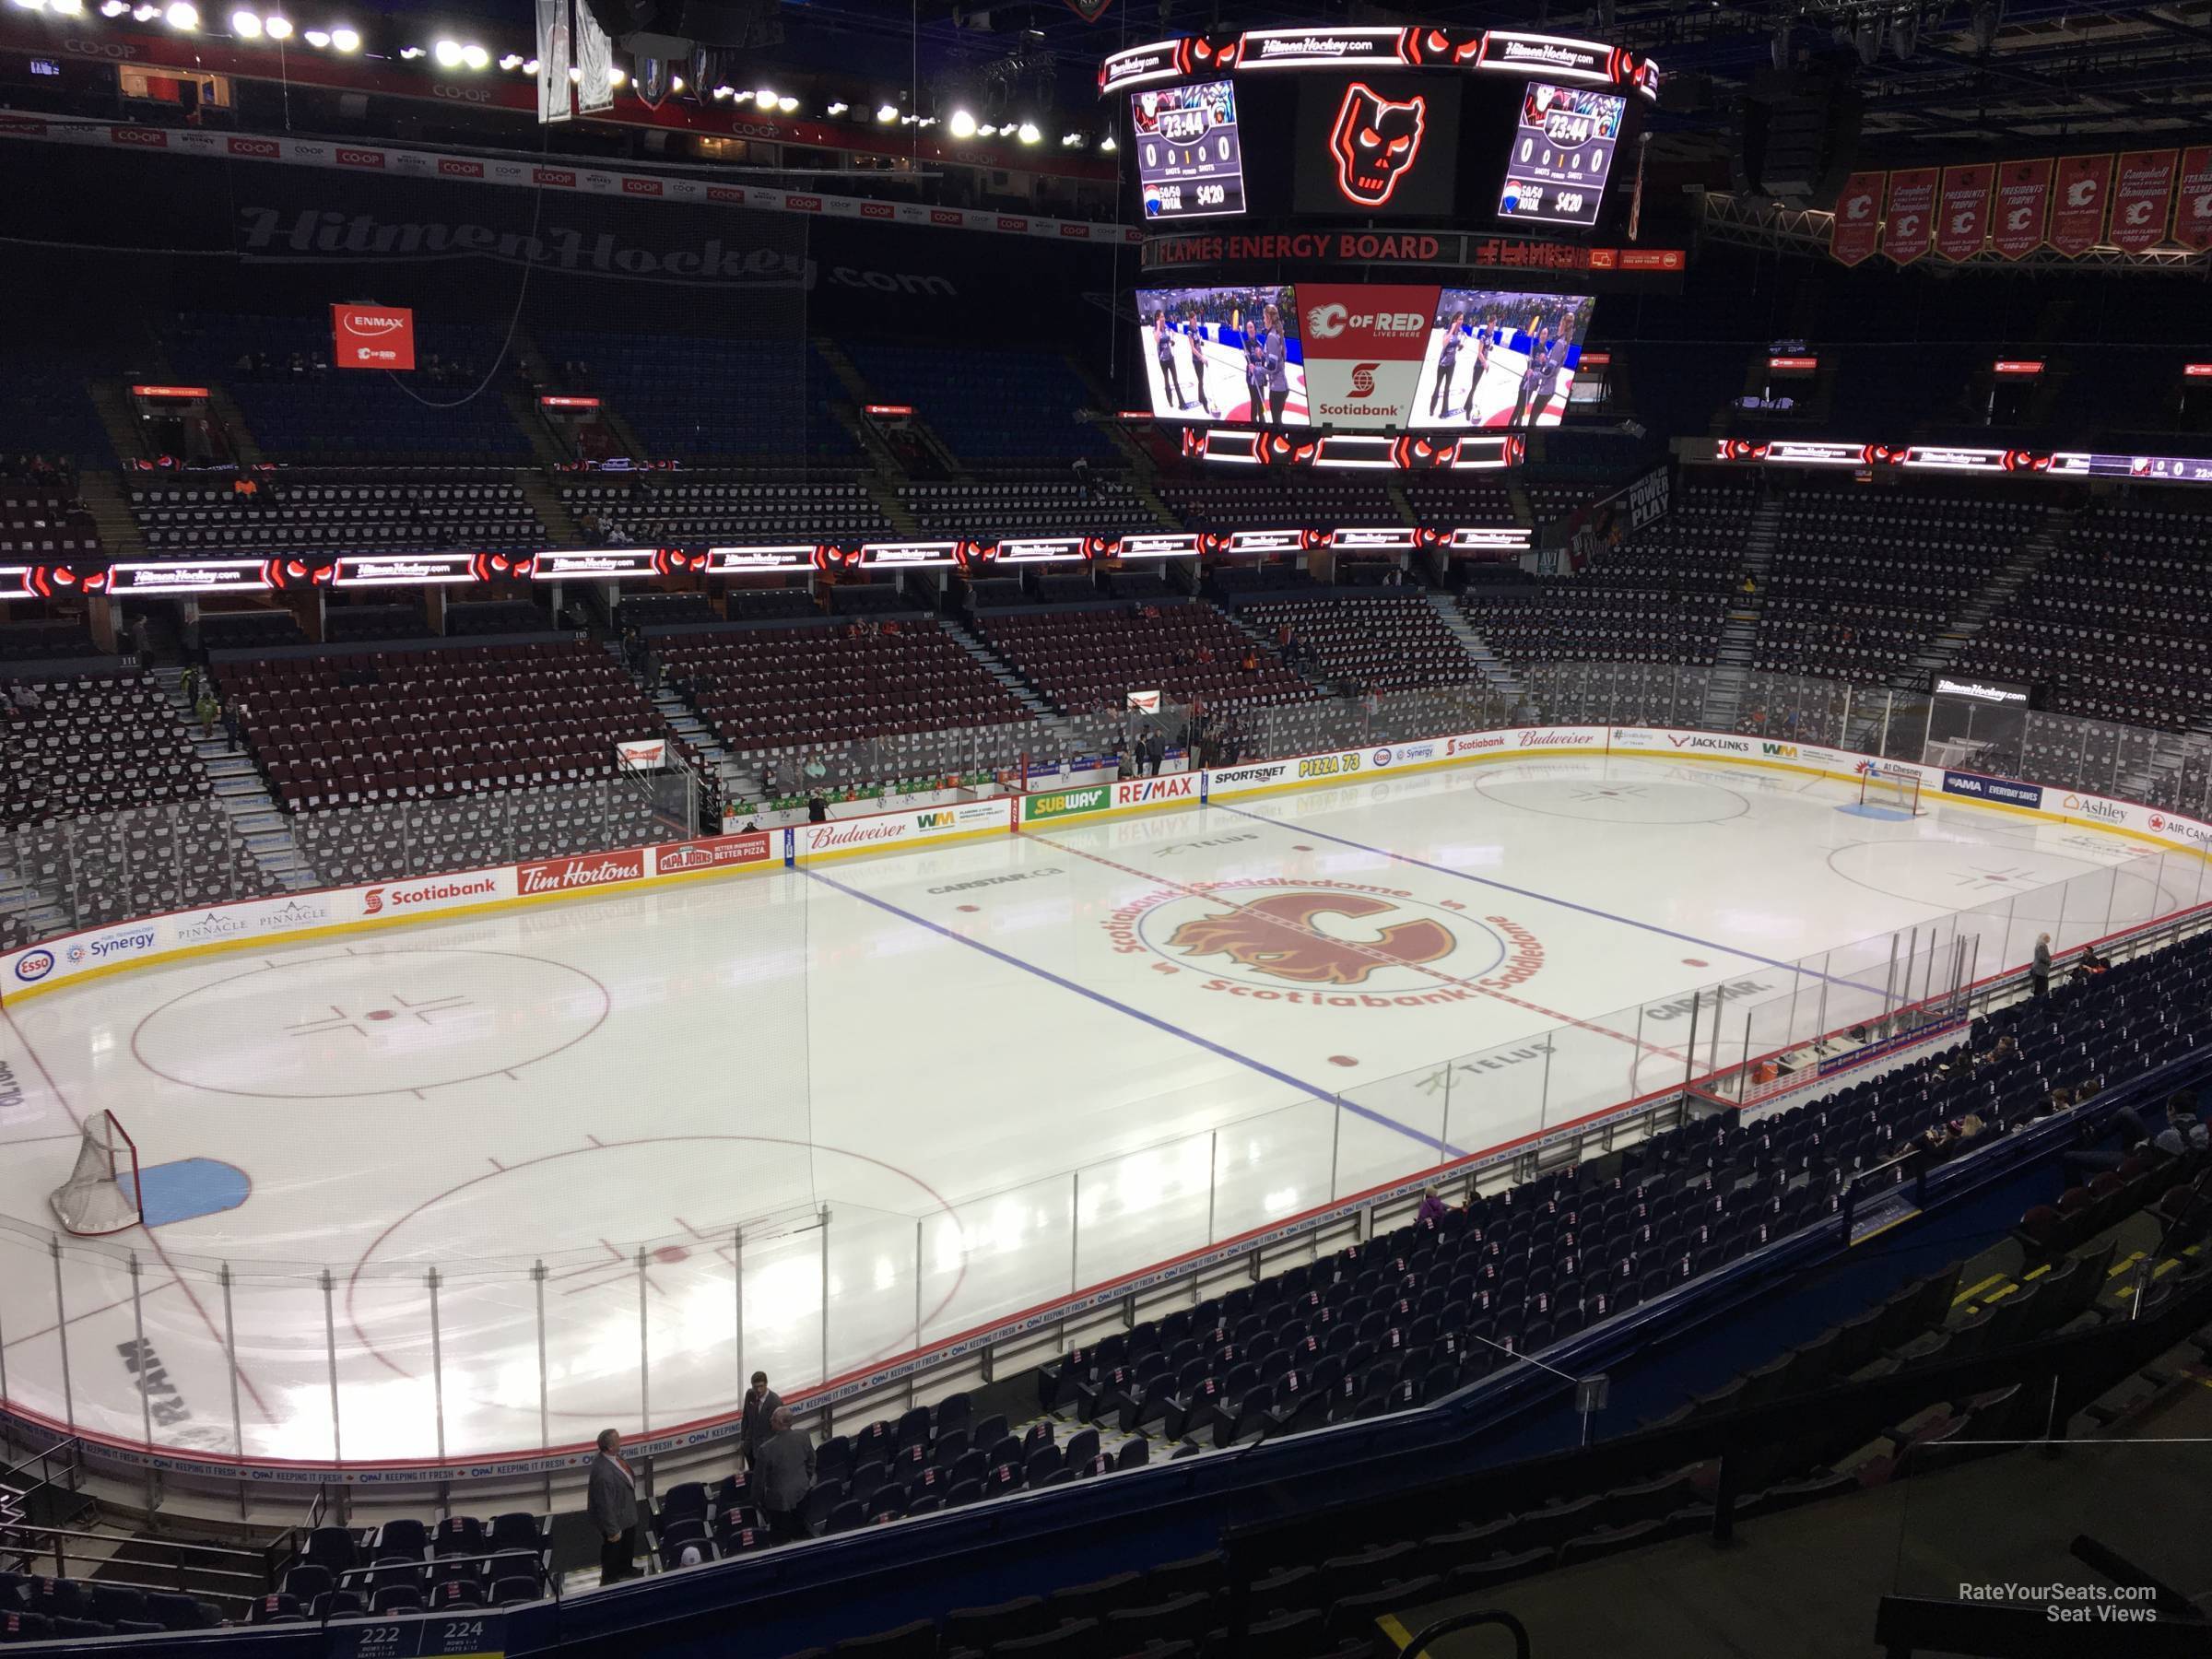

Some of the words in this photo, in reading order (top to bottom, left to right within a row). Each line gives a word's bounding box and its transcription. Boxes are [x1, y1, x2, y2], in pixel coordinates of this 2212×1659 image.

[65, 39, 137, 58] CO-OP
[432, 85, 490, 102] CO-OP
[732, 122, 780, 138] CO-OP
[1165, 112, 1204, 138] 23:44
[1548, 115, 1587, 141] 23:44
[118, 131, 160, 142] CO-OP
[234, 142, 274, 153] CO-OP
[1146, 144, 1157, 167] 0
[1169, 149, 1176, 164] 0
[1198, 147, 1206, 162] 0
[1218, 136, 1230, 160] 0
[1522, 138, 1533, 162] 0
[1543, 149, 1550, 165] 0
[1572, 154, 1580, 169] 0
[1592, 149, 1603, 171] 0
[342, 152, 379, 163] CO-OP
[442, 162, 478, 173] CO-OP
[538, 172, 571, 182] CO-OP
[627, 182, 657, 192] CO-OP
[1159, 186, 1181, 198] 50/50
[1197, 185, 1224, 206] $420
[790, 198, 818, 208] CO-OP
[1162, 197, 1182, 210] TOTAL
[1519, 198, 1539, 211] TOTAL
[1521, 186, 1543, 198] 50/50
[1556, 194, 1583, 212] $420
[864, 206, 891, 215] CO-OP
[935, 213, 959, 222] CO-OP
[1001, 219, 1024, 229] CO-OP
[1159, 236, 1223, 262] FLAMES
[1230, 235, 1331, 259] ENERGY
[1340, 235, 1439, 260] BOARD
[354, 315, 404, 328] ENMAX
[1349, 315, 1373, 327] OF
[1375, 313, 1424, 330] RED
[1320, 404, 1397, 416] Scotiabank
[2173, 462, 2183, 476] 0
[1630, 475, 1669, 509] POWER
[1631, 493, 1670, 530] PLAY
[134, 570, 241, 585] HitmenHockey.com
[1936, 680, 2027, 700] HitmenHockey.com
[1458, 737, 1505, 751] Scotiabank
[1517, 731, 1594, 747] Budweiser
[1689, 736, 1717, 749] JACK
[1718, 739, 1749, 752] LINK'S
[1374, 753, 1390, 762] Esso
[1406, 747, 1433, 759] Synergy
[1762, 743, 1797, 757] WM
[1299, 757, 1339, 777] PIZZA
[1342, 753, 1360, 771] 73
[1215, 766, 1286, 783] SPORTSNET
[1119, 776, 1193, 804] RE/MAX
[1954, 779, 1982, 792] AMA
[1989, 785, 2018, 799] EVERYDAY
[2018, 790, 2038, 802] SAVES
[1034, 790, 1102, 815] SUBWAY
[2079, 798, 2128, 823] Ashley
[917, 811, 955, 828] WM
[2167, 821, 2185, 835] AIR
[807, 822, 906, 850] Budweiser
[1186, 833, 1259, 849] TELUS
[662, 854, 683, 869] PAPA
[685, 852, 711, 865] JOHNS
[714, 850, 742, 860] BETTER
[522, 866, 559, 892] Tim
[562, 861, 641, 885] Hortons
[927, 866, 1065, 895] CARSTAR.ca
[391, 878, 496, 906] Scotiabank
[259, 907, 327, 925] PINNACLE
[1100, 888, 1175, 954] Scotiabank
[1190, 877, 1414, 899] Saddledome
[178, 921, 248, 939] PINNACLE
[90, 931, 155, 957] Synergy
[21, 957, 49, 973] Esso
[1202, 979, 1477, 1007] Scotiabank
[1481, 915, 1546, 990] Saddledome
[1458, 1041, 1557, 1075] TELUS
[890, 1363, 914, 1379] KEEPING
[922, 1354, 940, 1368] FRESH
[385, 1471, 418, 1481] KEEPING
[429, 1469, 453, 1479] FRESH
[471, 1466, 494, 1477] OPA!
[498, 1464, 529, 1475] KEEPING
[541, 1458, 565, 1469] FRESH
[359, 1627, 400, 1644] 222
[443, 1621, 483, 1638] 224
